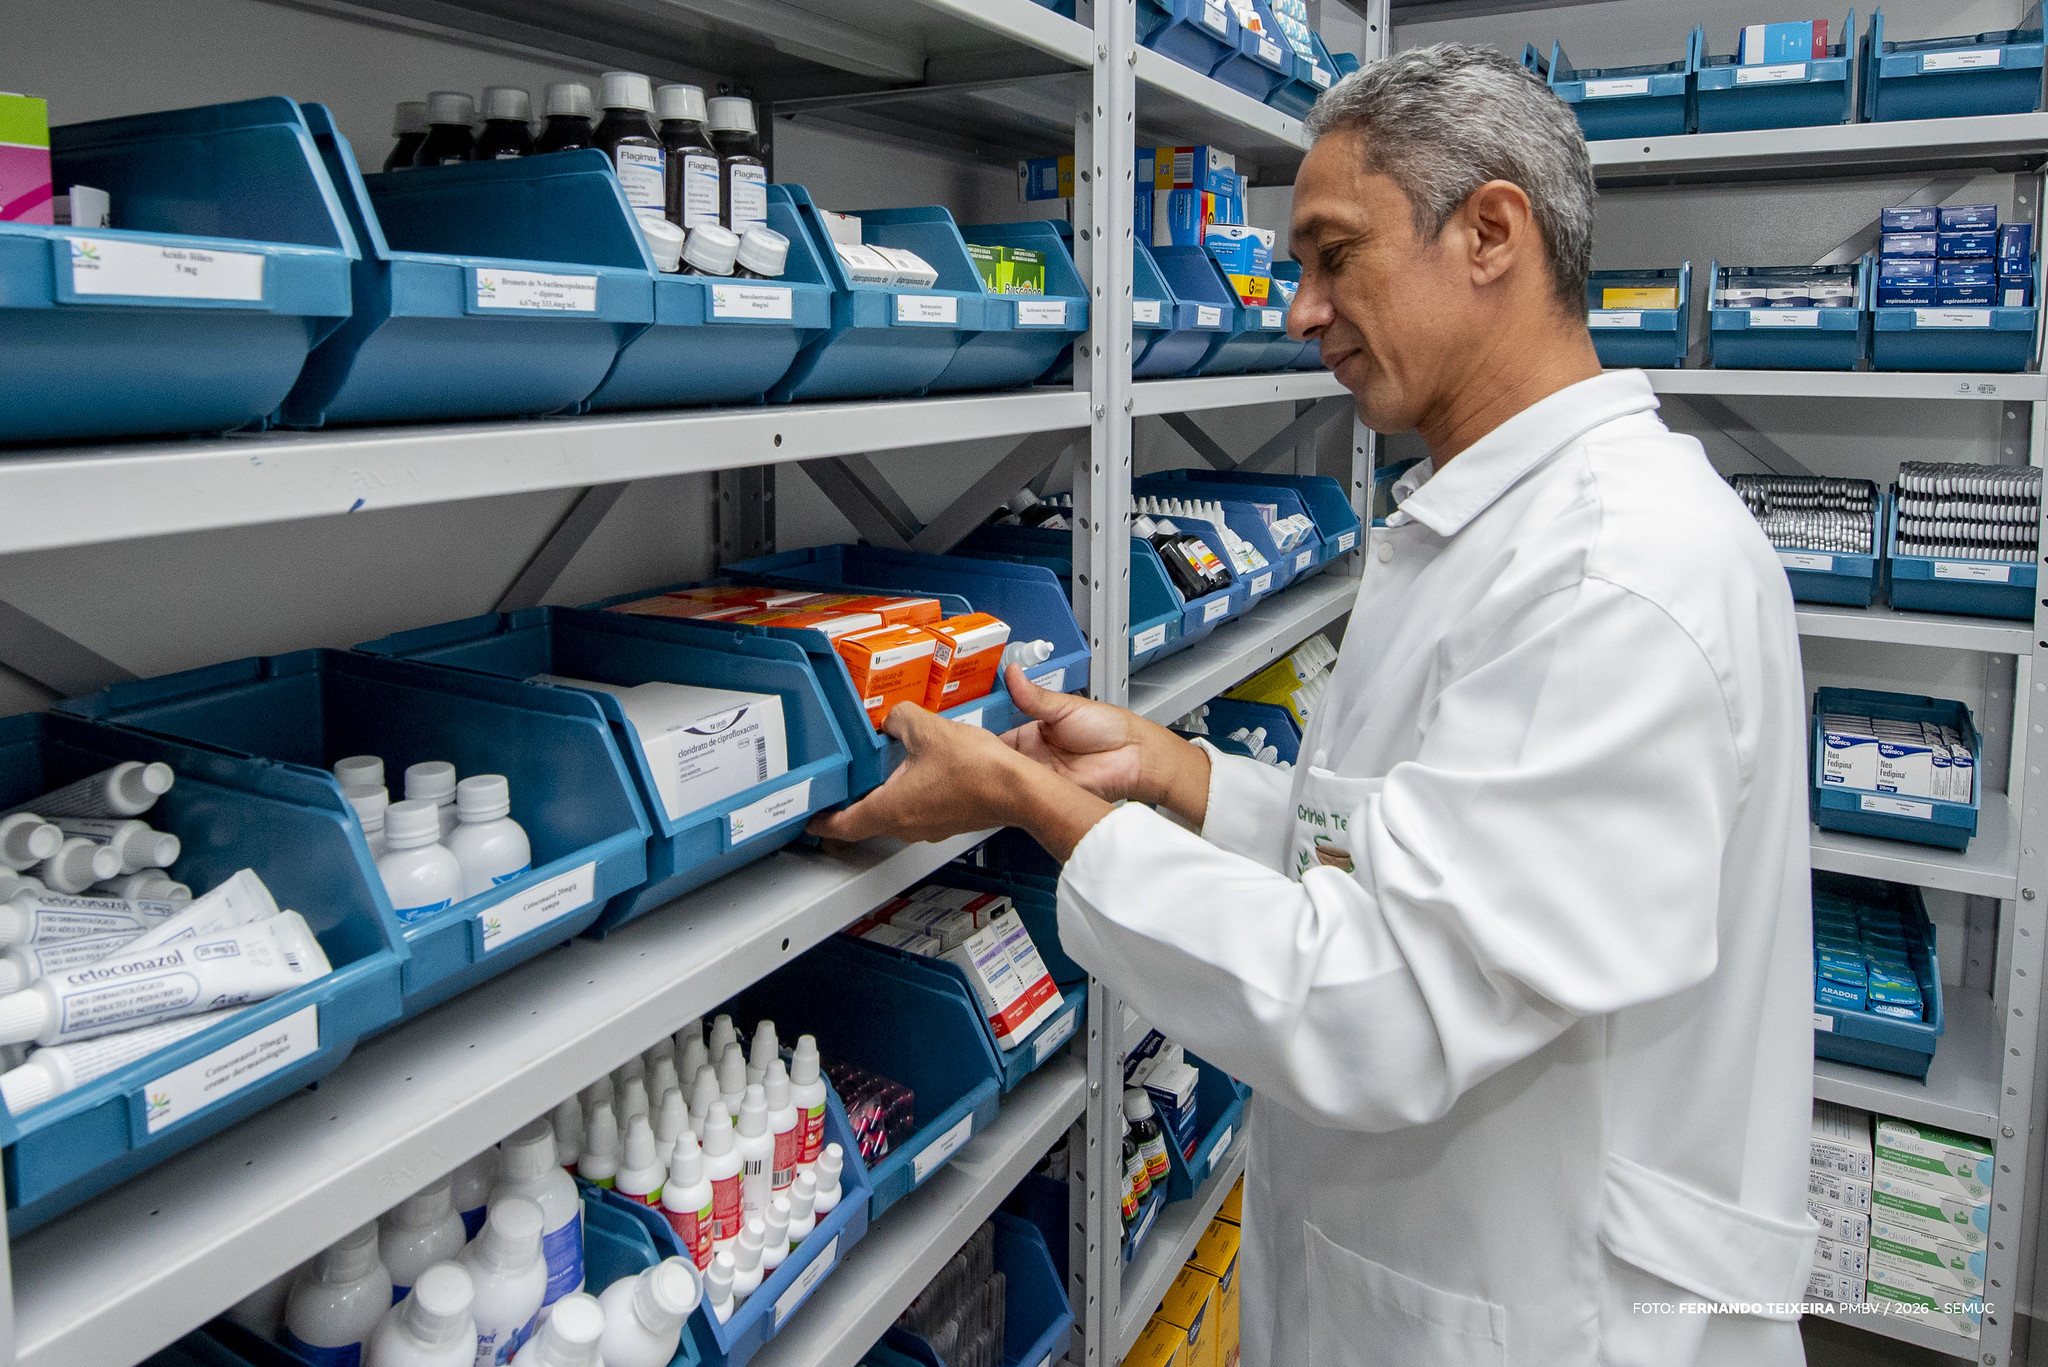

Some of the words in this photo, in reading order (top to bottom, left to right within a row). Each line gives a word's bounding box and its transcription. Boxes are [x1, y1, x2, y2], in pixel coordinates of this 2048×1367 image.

[620, 151, 657, 162] Flagimax
[688, 161, 717, 172] Flagimax
[734, 170, 763, 180] Flagimax
[896, 277, 924, 286] dipropionato
[678, 742, 708, 759] cloridrato
[708, 739, 717, 748] de
[717, 723, 759, 744] ciprofloxacino
[1827, 759, 1852, 769] Fedipina
[1880, 760, 1893, 769] Neo
[1880, 769, 1906, 779] Fedipina
[68, 949, 185, 985] cetoconazol
[70, 997, 89, 1007] USO
[90, 980, 165, 1003] DERMATOLÓGICO
[1821, 987, 1859, 1000] ARADOIS
[70, 1010, 89, 1019] USO
[91, 1002, 127, 1014] ADULTO
[135, 987, 184, 1003] PEDIÁTRICO
[69, 1009, 133, 1029] MEDICAMENTO
[136, 997, 189, 1014] NOTIFICADO
[1876, 1005, 1914, 1016] ARADOIS
[205, 1048, 257, 1078] Cetoconazol
[1895, 1140, 1924, 1153] dialife
[1891, 1186, 1921, 1199] dialife
[1888, 1232, 1918, 1243] dialife
[1885, 1277, 1915, 1289] dialife
